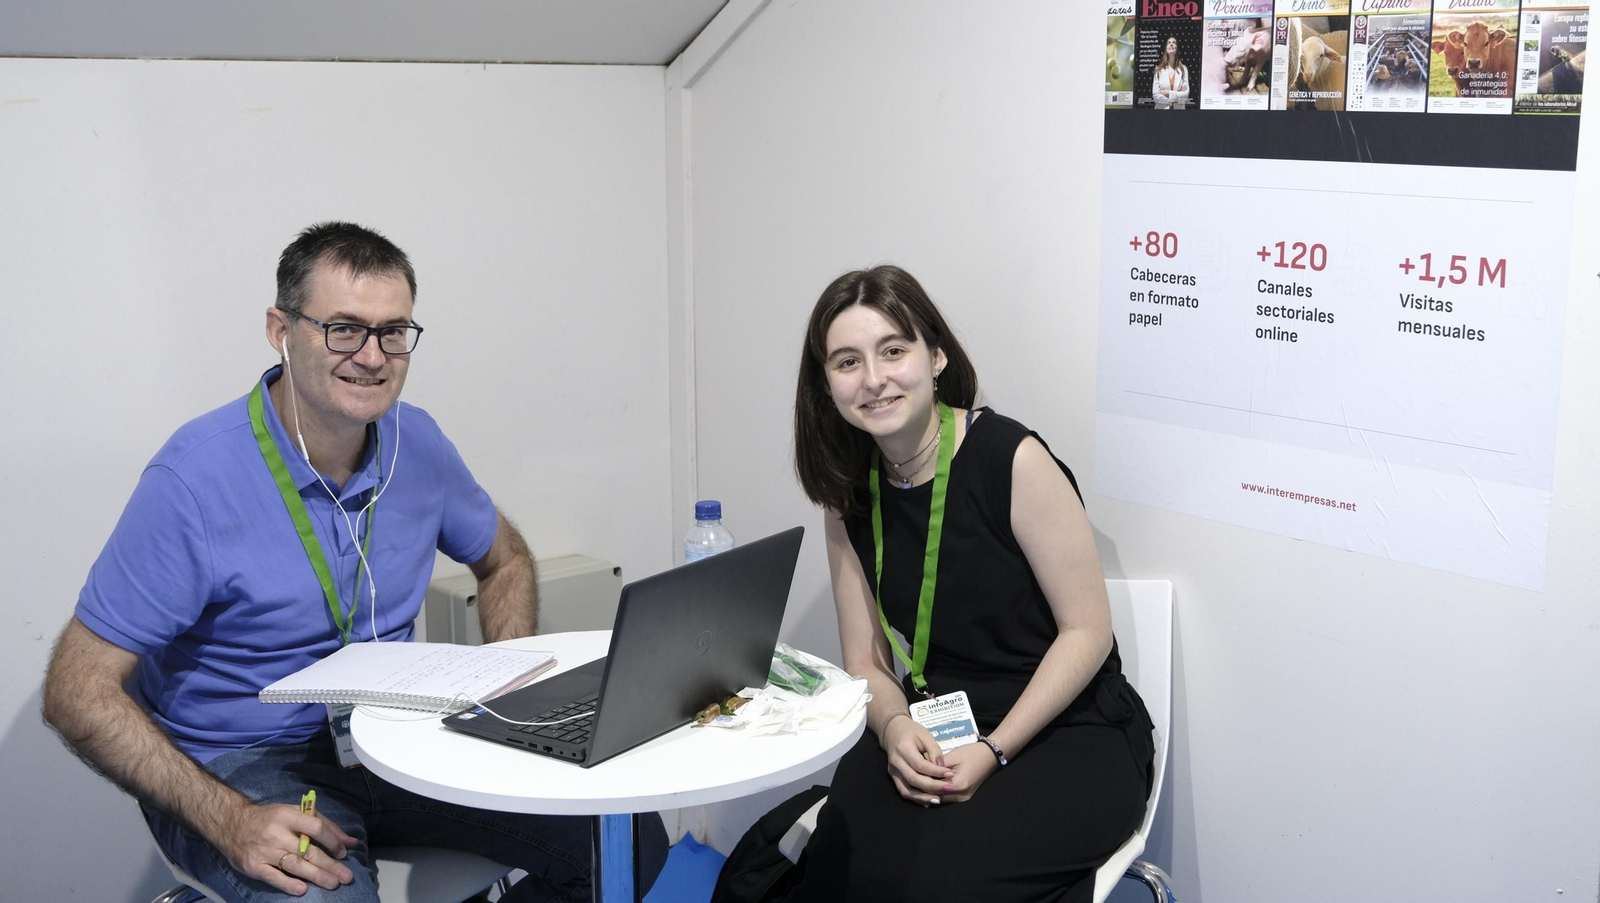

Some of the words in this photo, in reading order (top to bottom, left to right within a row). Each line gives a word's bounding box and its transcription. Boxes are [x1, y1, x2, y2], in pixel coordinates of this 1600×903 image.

[1140, 0, 1199, 18] Eneo
[1213, 0, 1256, 15] Porcino
[1276, 31, 1287, 40] PR
[1355, 29, 1366, 38] PR
[1551, 34, 1568, 43] sobre
[1469, 80, 1508, 88] estrategias
[1129, 231, 1178, 258] +80
[1256, 241, 1328, 271] +120
[1130, 267, 1197, 286] Cabeceras
[1399, 252, 1468, 288] +1,5
[1477, 257, 1507, 288] M
[1257, 279, 1313, 298] Canales
[1129, 291, 1145, 303] en
[1148, 290, 1199, 308] formato
[1400, 293, 1454, 314] Visitas
[1129, 312, 1163, 327] papel
[1256, 304, 1335, 324] sectoriales
[1255, 326, 1298, 343] online
[1398, 320, 1486, 342] mensuales
[1241, 482, 1357, 512] www.interempresas.net
[928, 697, 963, 709] infoAgro
[940, 725, 965, 735] cajamar
